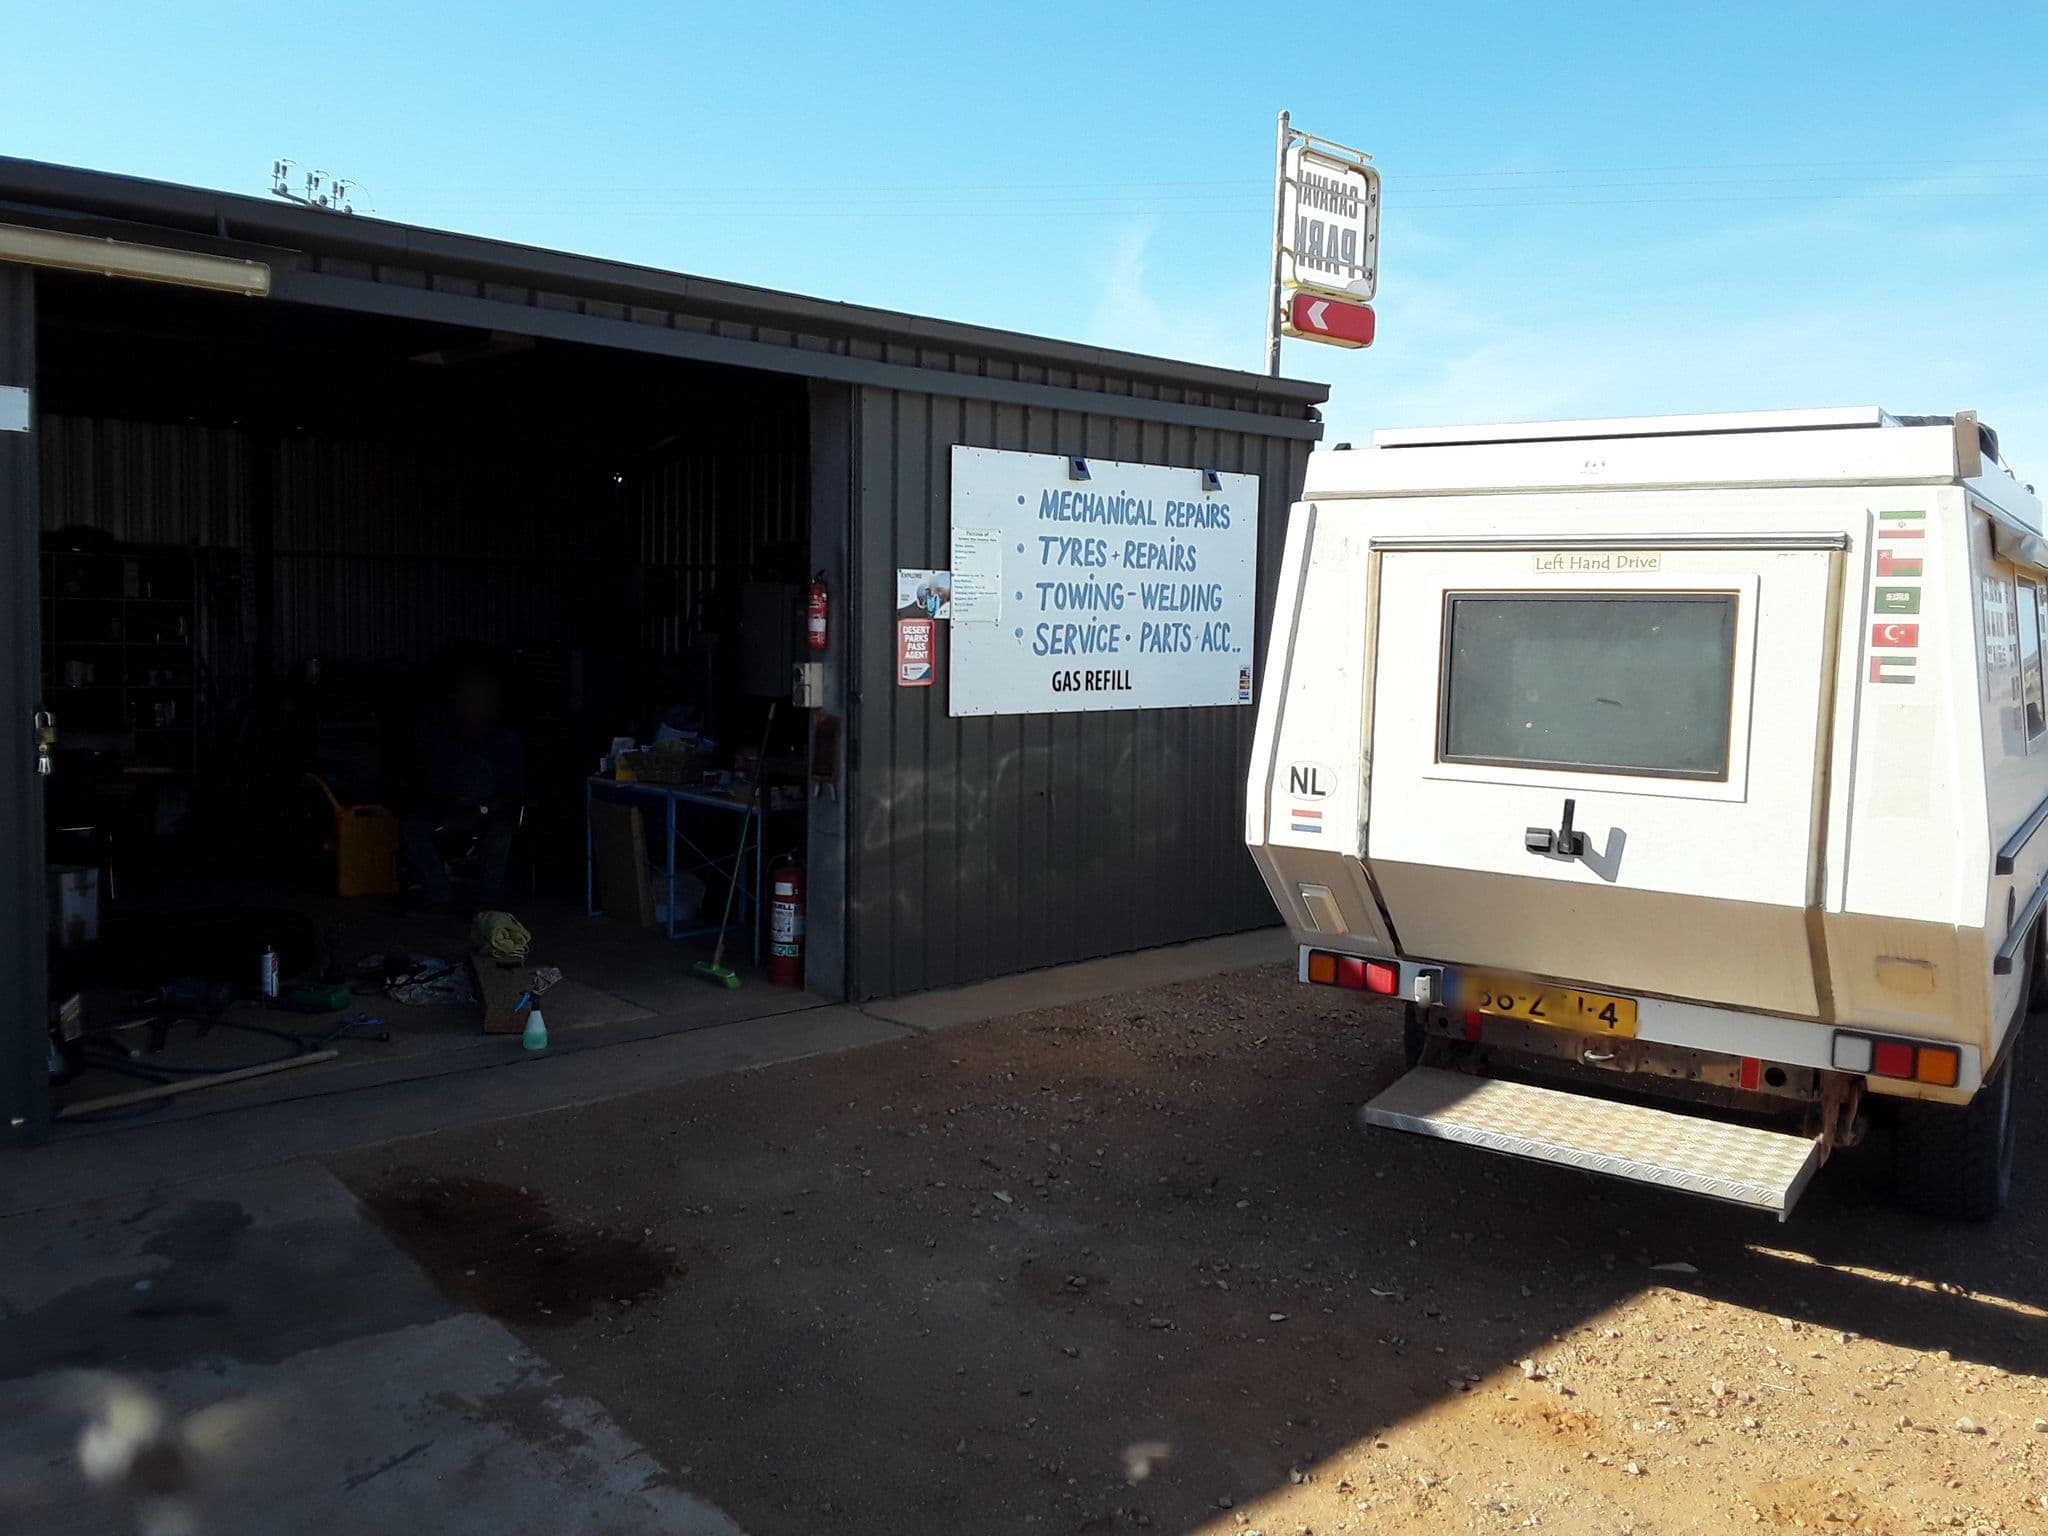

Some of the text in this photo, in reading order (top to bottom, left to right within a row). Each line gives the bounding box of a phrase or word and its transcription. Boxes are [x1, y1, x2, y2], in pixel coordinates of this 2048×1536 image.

[1039, 489, 1230, 529] MECHANICAL REPAIRS
[1039, 536, 1107, 568] TYRES
[1123, 536, 1196, 572] REPAIRS
[1536, 553, 1657, 570] Left Hand Drive
[1036, 573, 1124, 611] TOWING
[1140, 582, 1222, 612] WELDING
[902, 626, 930, 634] DESERT
[904, 634, 929, 642] PARKS
[1032, 616, 1120, 656] SERVICE
[1139, 622, 1191, 653] PARTS
[904, 650, 928, 659] AGENT
[907, 642, 926, 650] PASS
[1052, 670, 1132, 692] GAS REFILL
[1290, 766, 1326, 796] NL
